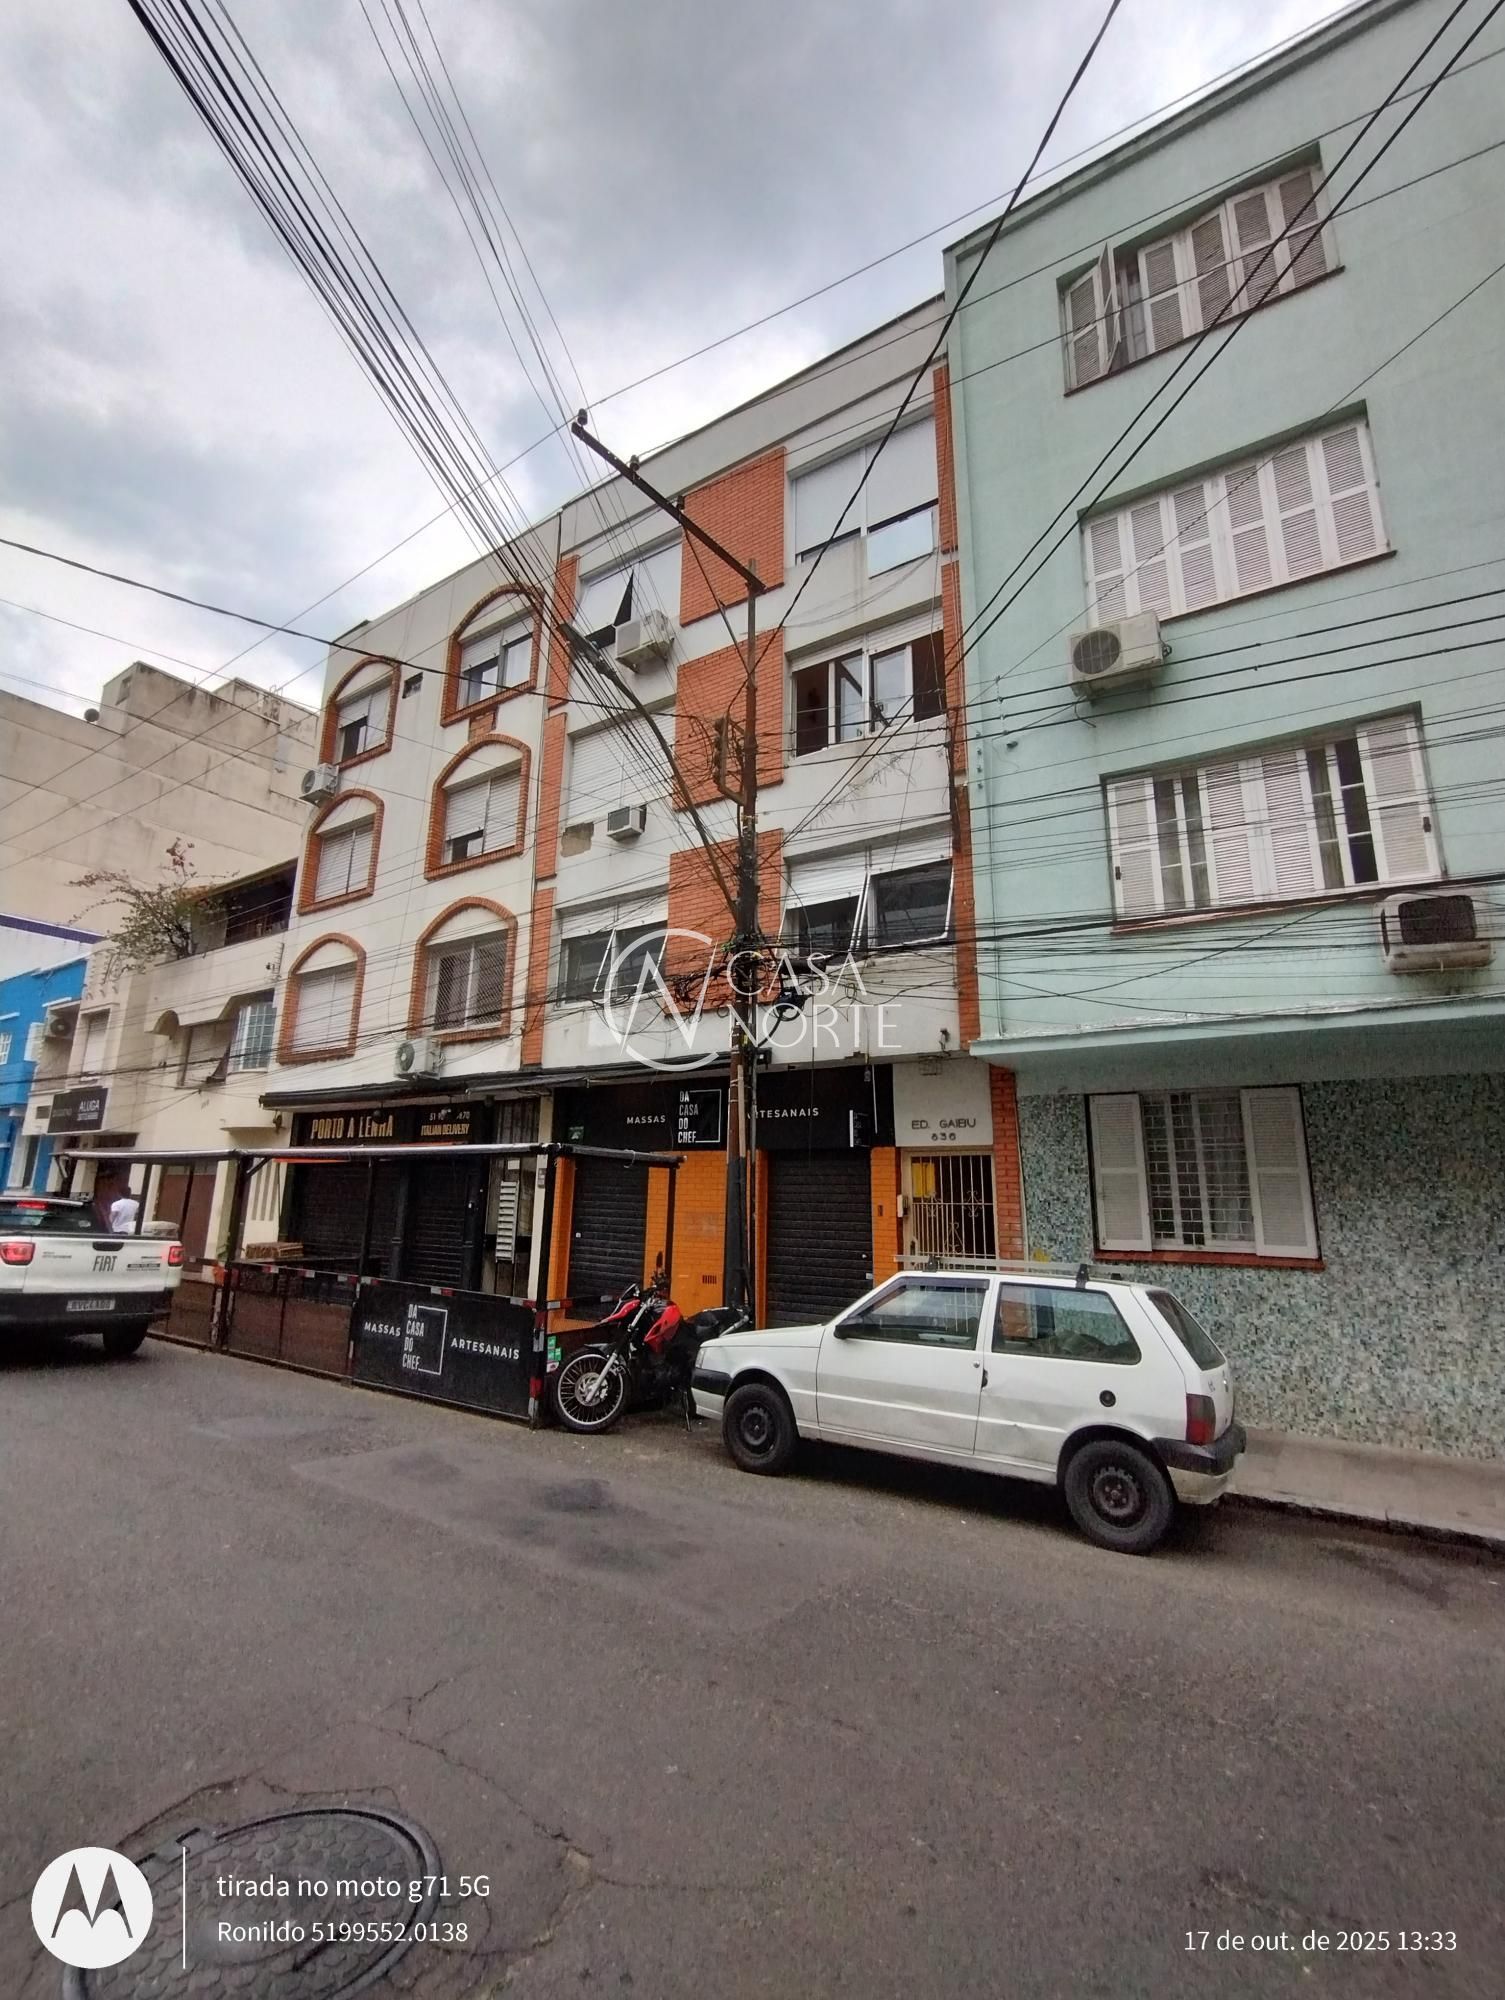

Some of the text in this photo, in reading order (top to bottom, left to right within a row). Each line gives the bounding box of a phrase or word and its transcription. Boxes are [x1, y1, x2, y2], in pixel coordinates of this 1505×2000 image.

[679, 1091, 690, 1103] DA
[79, 1099, 100, 1112] ALUGA
[679, 1104, 699, 1116] CASA
[626, 1115, 666, 1125] MASSAS
[678, 1117, 689, 1130] DO
[939, 1118, 977, 1129] GAIBU
[310, 1117, 344, 1139] PORTO
[347, 1117, 355, 1139] A
[420, 1123, 470, 1137] ITALIAN DELIVERY
[677, 1131, 696, 1143] CHEF
[92, 1255, 118, 1272] FIAT
[407, 1303, 418, 1319] DA
[364, 1321, 401, 1337] MASSAS
[405, 1320, 425, 1337] CASA
[404, 1336, 414, 1352] DO
[450, 1337, 520, 1360] ARTESANAIS
[402, 1352, 421, 1371] CHEF
